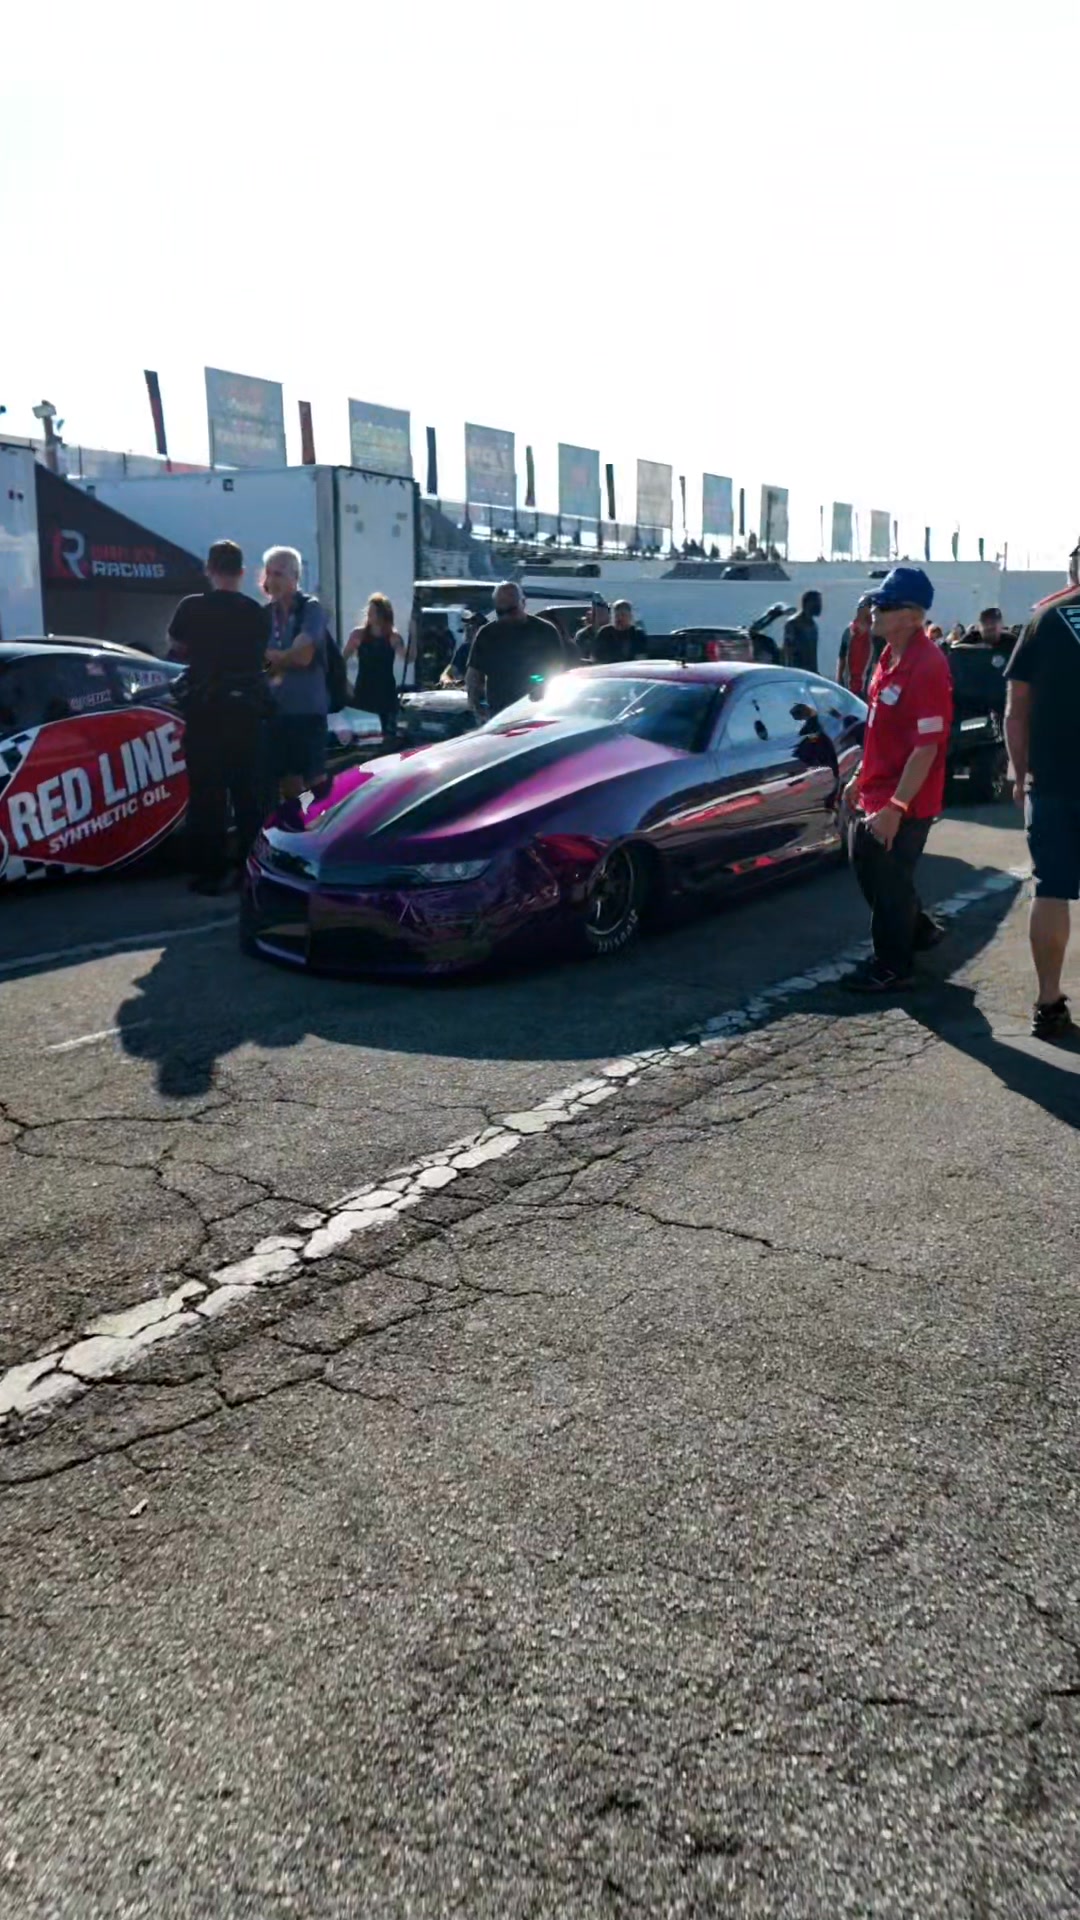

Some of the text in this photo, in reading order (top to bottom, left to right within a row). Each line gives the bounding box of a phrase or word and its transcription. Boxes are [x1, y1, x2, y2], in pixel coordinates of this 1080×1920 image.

[91, 561, 166, 579] RACING
[8, 721, 187, 850] RED LINE
[49, 784, 171, 854] SYNTHETIC OIL
